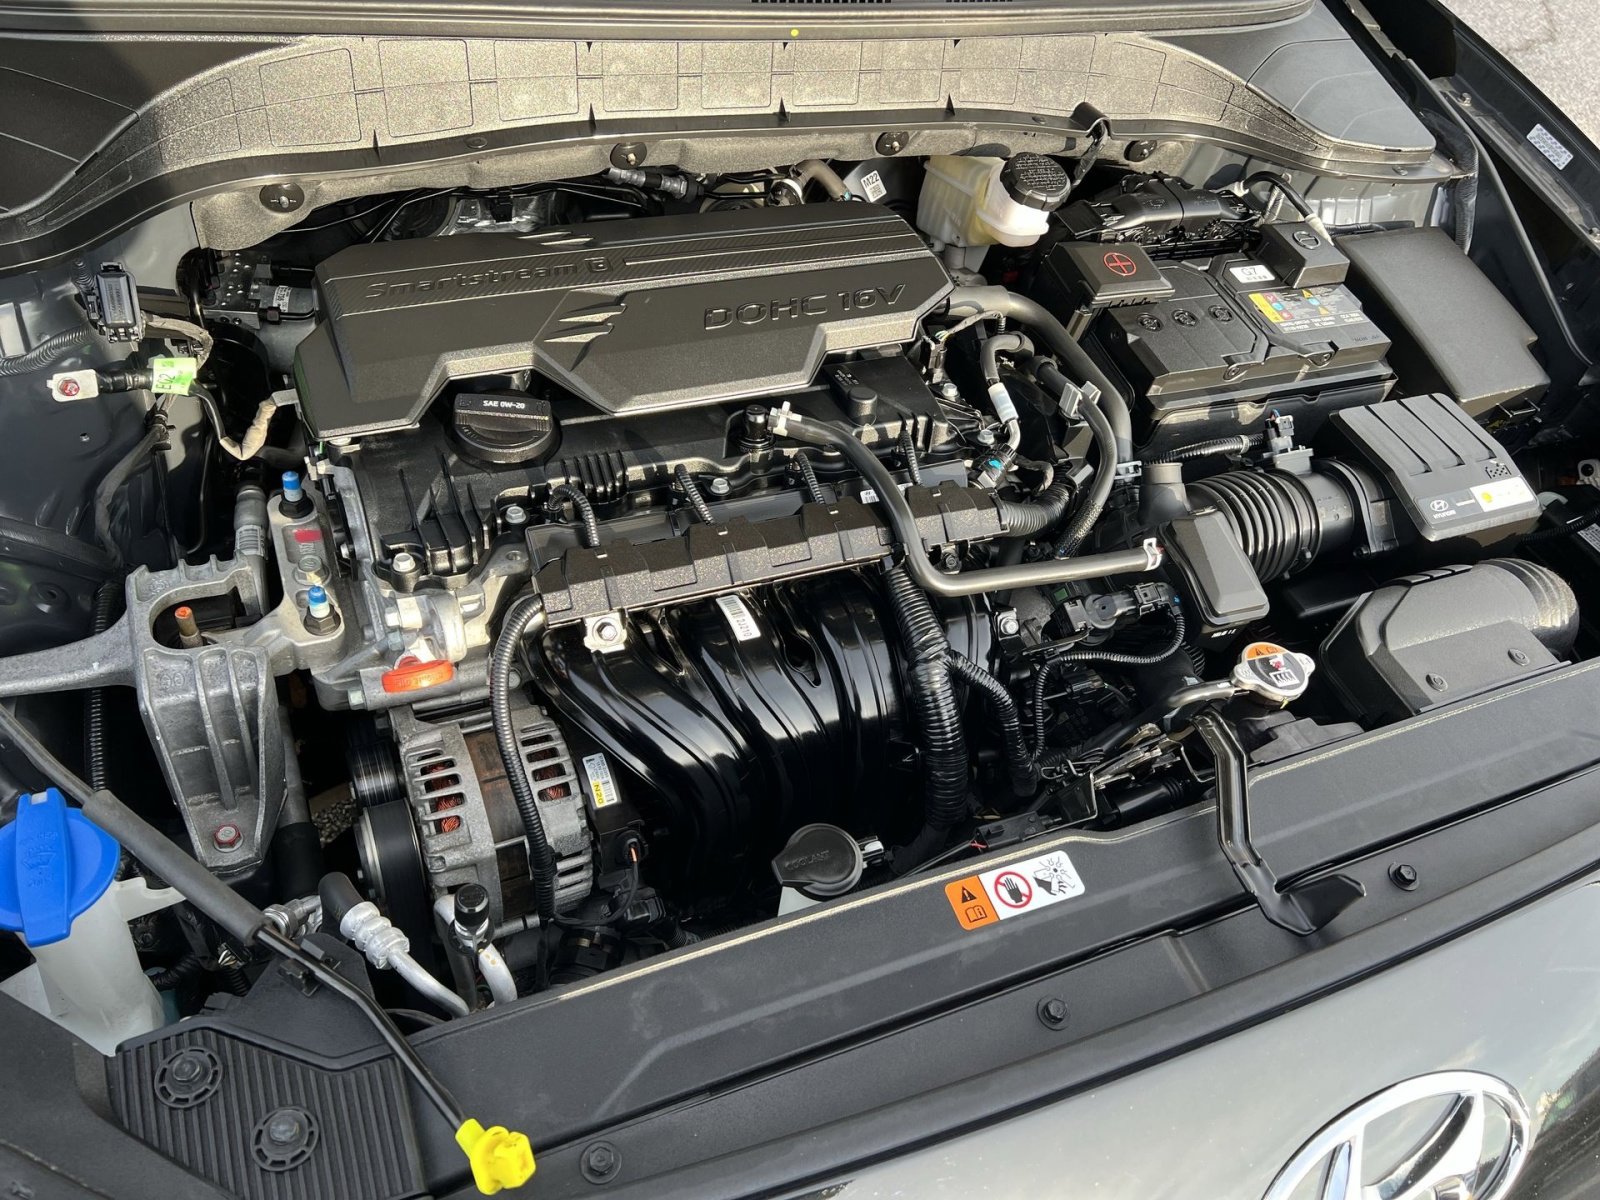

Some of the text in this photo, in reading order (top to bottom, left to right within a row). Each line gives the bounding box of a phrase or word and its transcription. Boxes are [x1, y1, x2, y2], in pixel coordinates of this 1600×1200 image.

[862, 172, 880, 189] M22
[365, 264, 578, 299] Smartstream
[704, 283, 906, 331] DOHC 16V
[482, 400, 499, 408] SAE
